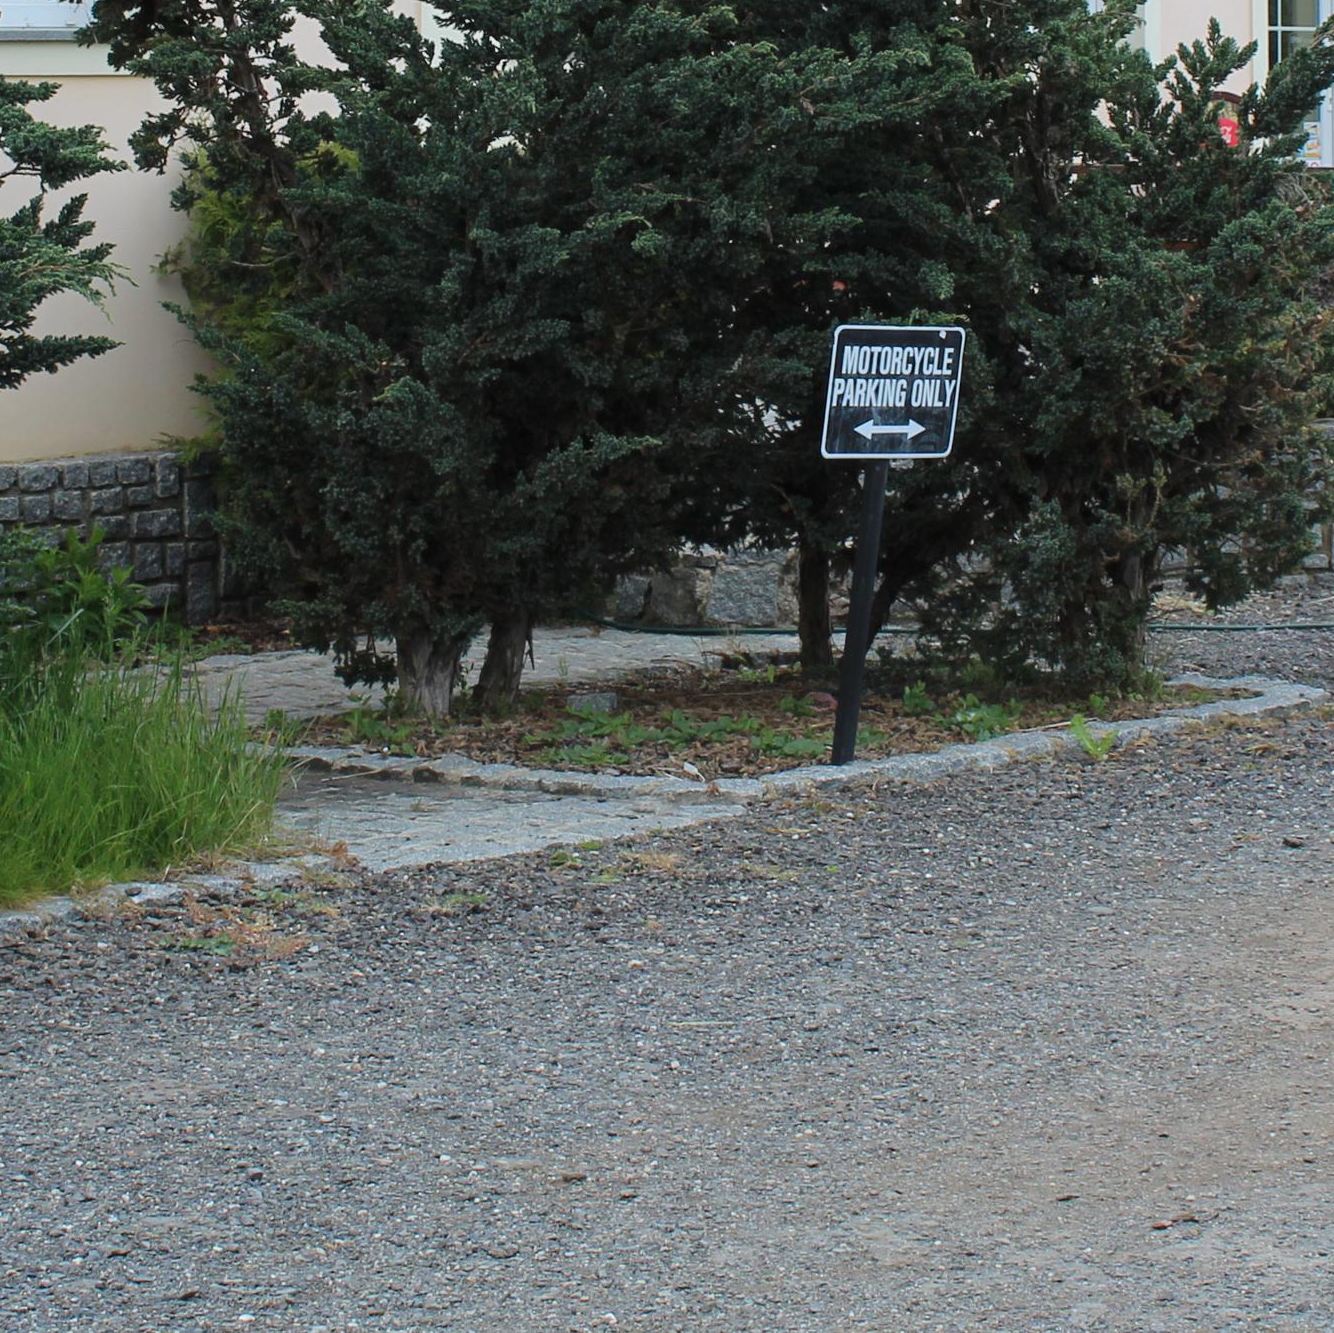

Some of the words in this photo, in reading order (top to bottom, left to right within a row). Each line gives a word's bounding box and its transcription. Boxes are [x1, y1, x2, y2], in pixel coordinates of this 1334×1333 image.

[841, 345, 955, 376] MOTORCYCLE
[831, 378, 907, 408] PARKING
[910, 379, 957, 408] ONLY
